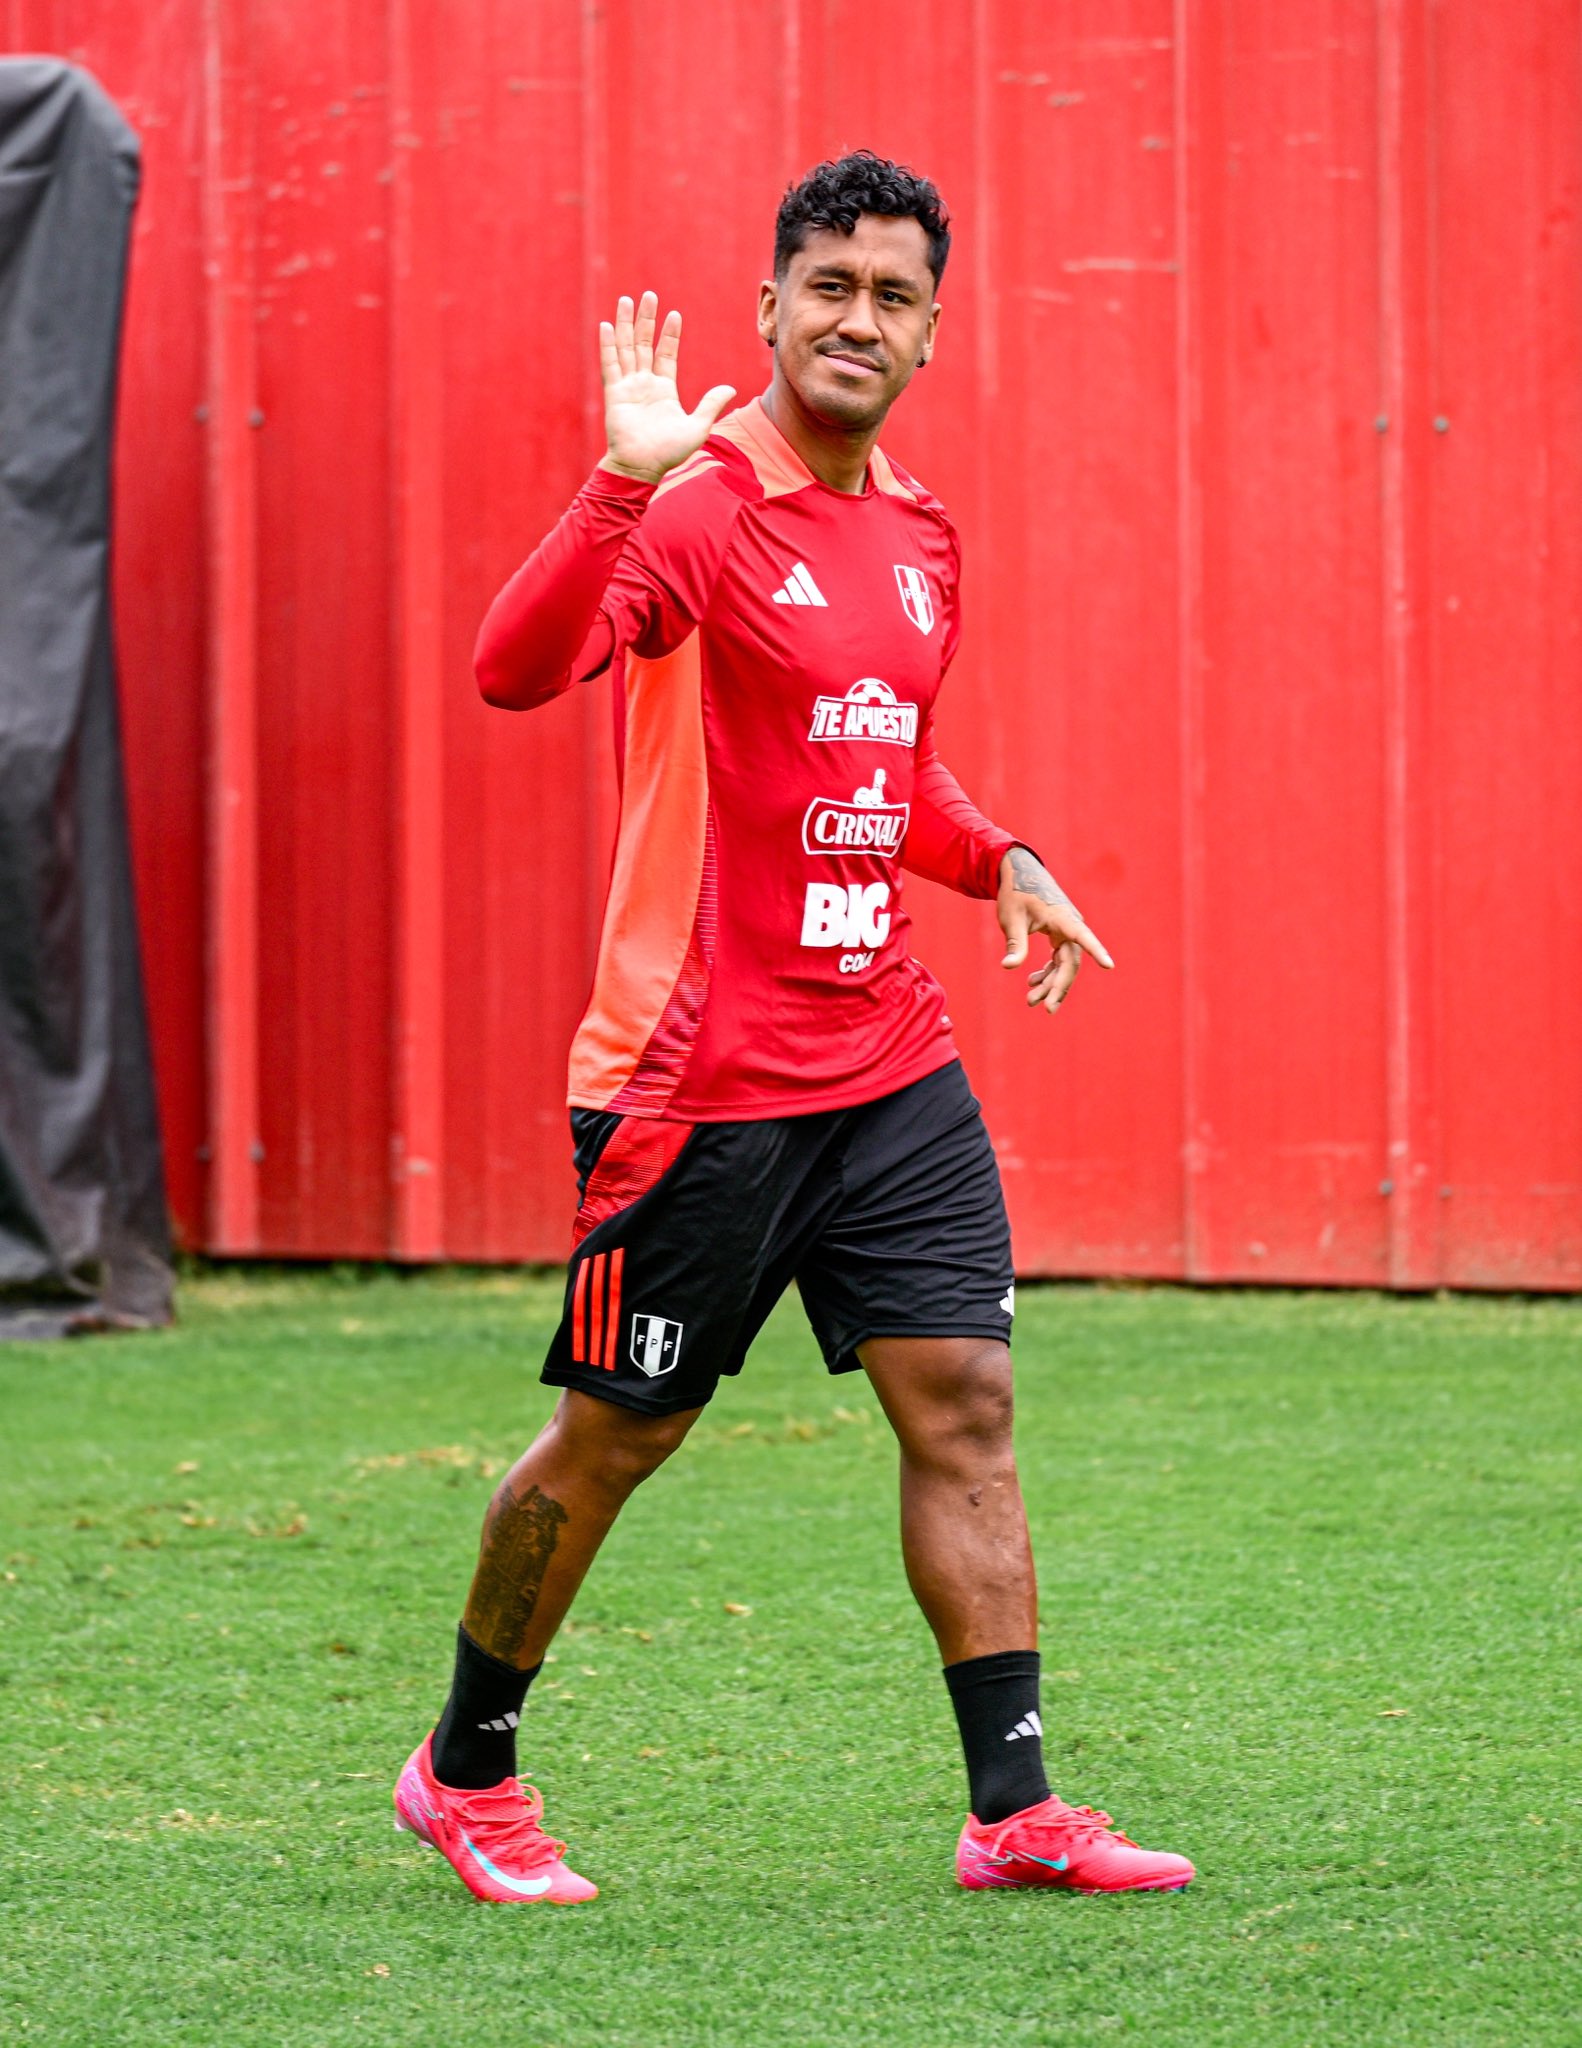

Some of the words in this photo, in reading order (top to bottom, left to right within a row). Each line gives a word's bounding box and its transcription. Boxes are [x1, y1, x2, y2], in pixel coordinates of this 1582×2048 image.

[813, 701, 844, 737] TE
[843, 704, 915, 743] APUESTO
[814, 810, 905, 847] CRISTAL
[800, 882, 891, 948] BIG
